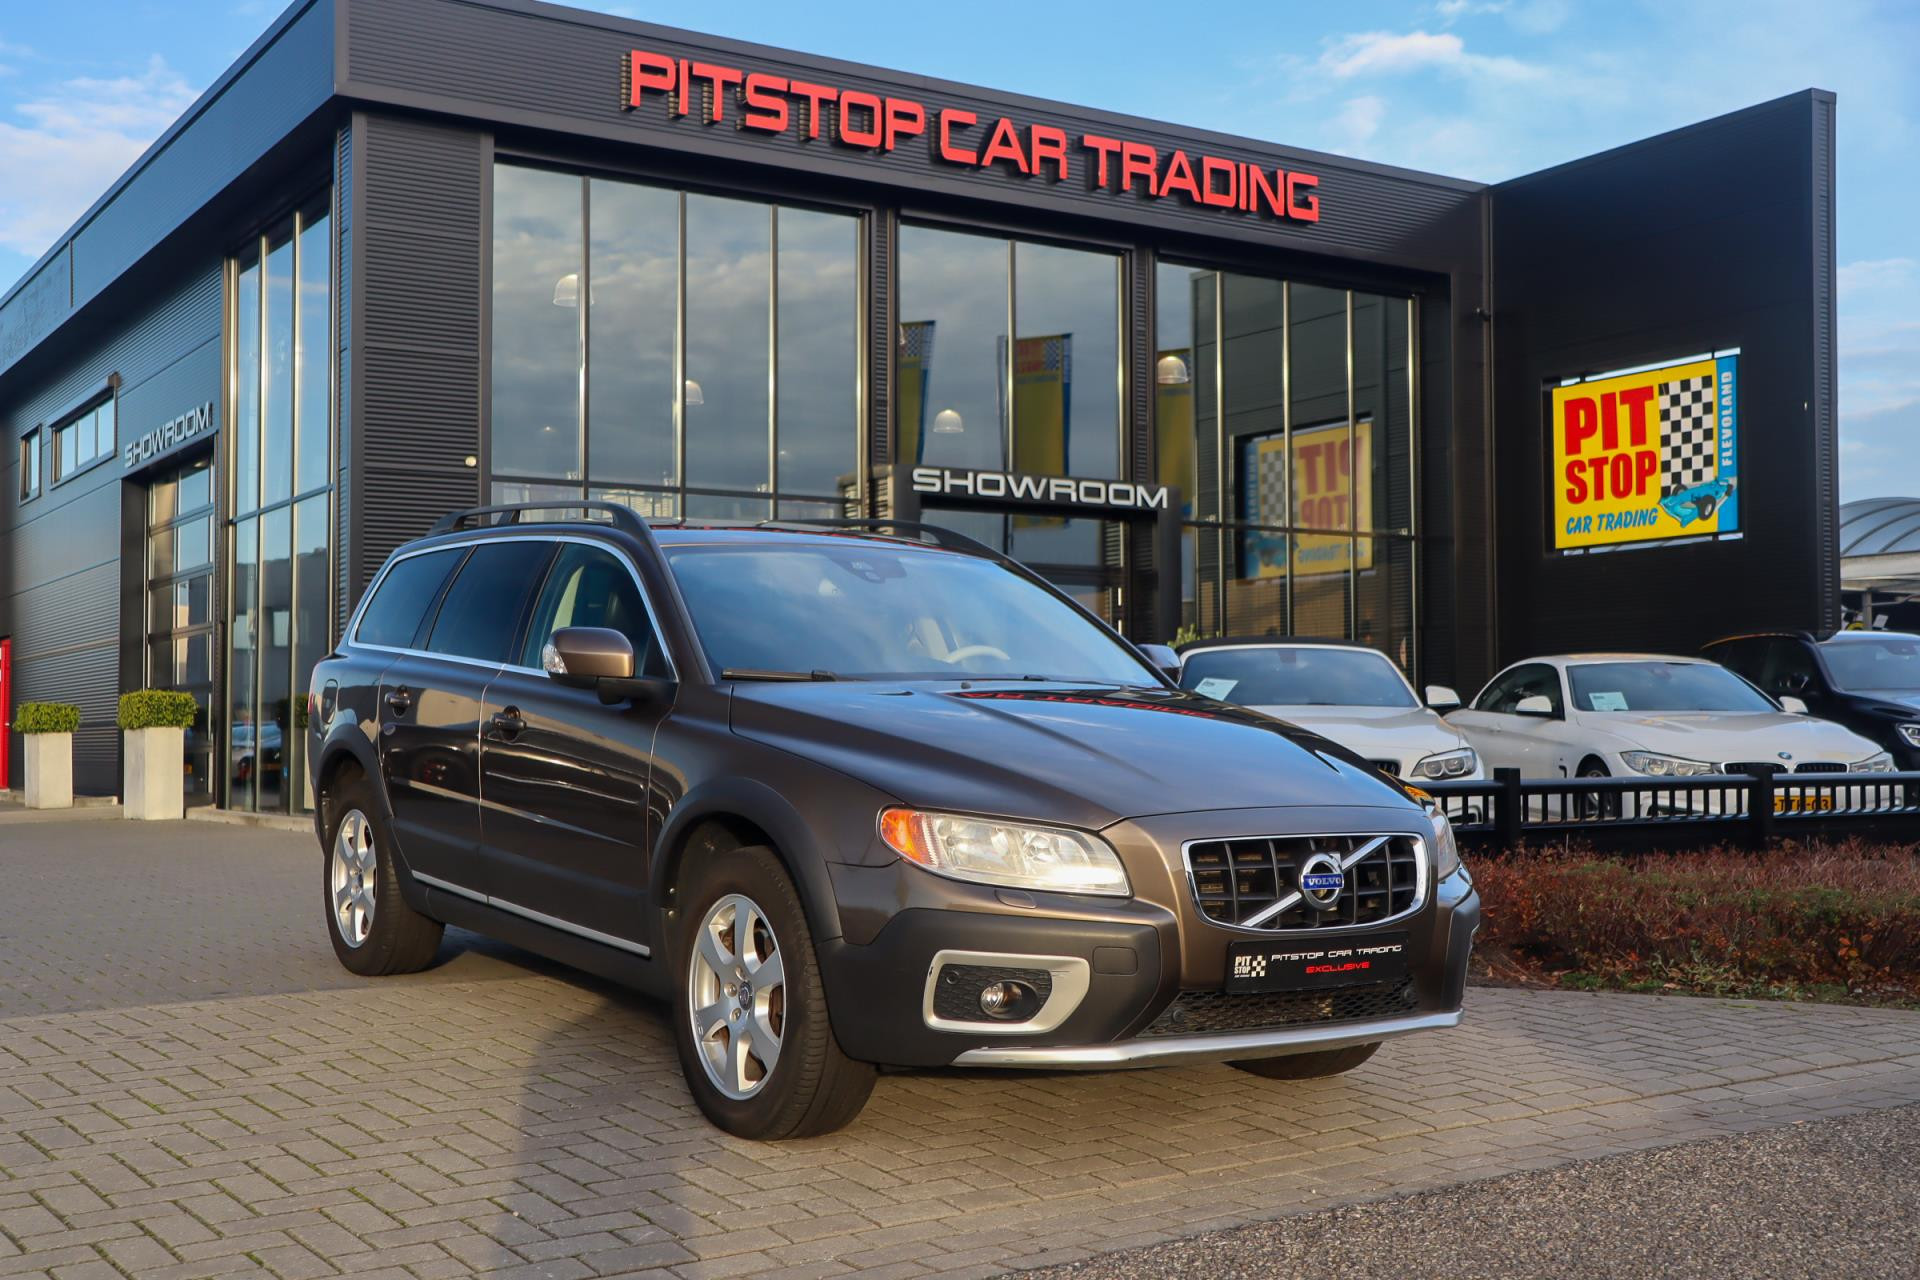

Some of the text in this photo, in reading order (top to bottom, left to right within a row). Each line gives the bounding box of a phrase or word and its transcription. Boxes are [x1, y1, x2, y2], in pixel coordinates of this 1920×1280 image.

[628, 49, 1320, 223] PITSTOP CAR TRADING
[124, 401, 211, 469] SHOWROOM
[1564, 385, 1655, 456] PIT
[1721, 371, 1733, 467] FLEVOLAND
[911, 467, 1169, 509] SHOWROOM
[1565, 450, 1657, 505] STOP
[1566, 508, 1658, 535] CAR TRADING
[1308, 877, 1342, 886] VOLVO
[1234, 966, 1251, 974] STOP
[1235, 955, 1252, 967] PIT
[1271, 944, 1402, 962] PITSTOP CAR TRADING
[1305, 961, 1371, 974] EXCLUSIVE
